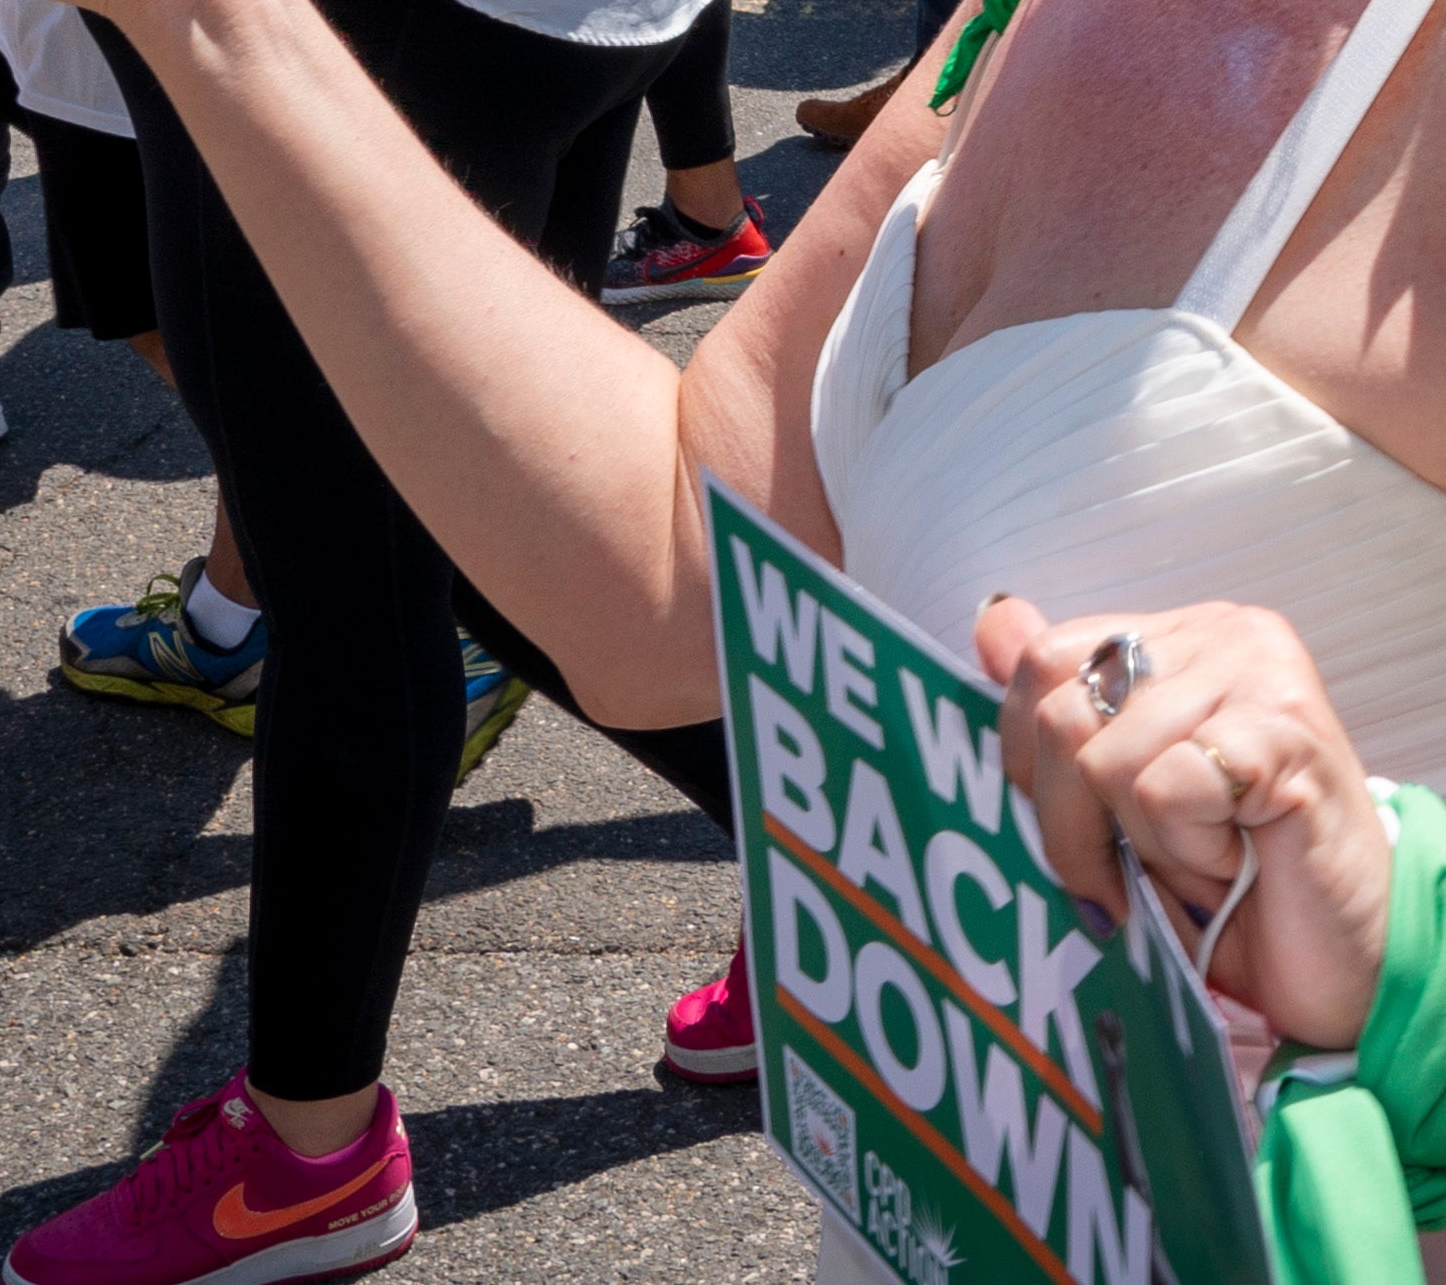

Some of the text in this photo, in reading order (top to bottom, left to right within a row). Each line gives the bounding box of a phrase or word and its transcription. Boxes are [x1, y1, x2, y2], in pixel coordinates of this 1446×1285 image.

[730, 535, 885, 750] WE
[749, 674, 1104, 1116] BACK
[328, 1212, 359, 1231] MOVE
[360, 1198, 389, 1218] YOUR
[767, 847, 1153, 1285] DOWN
